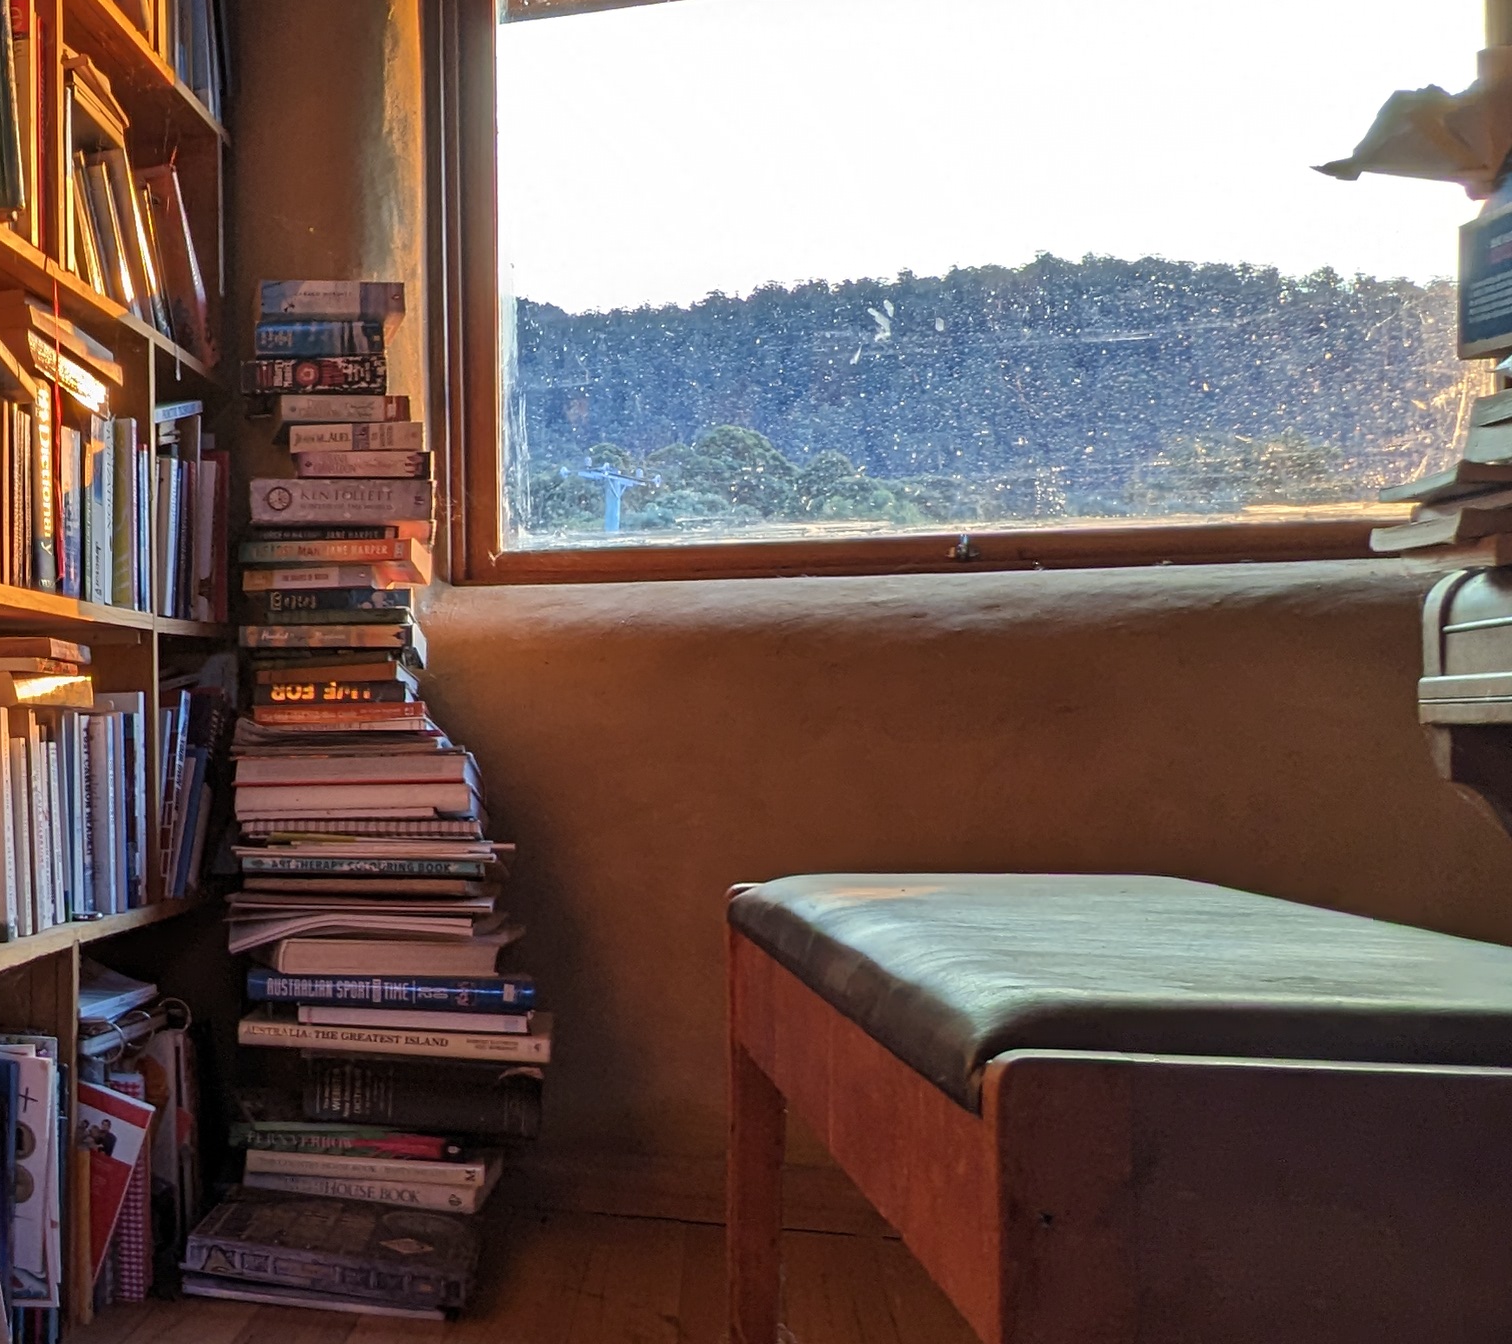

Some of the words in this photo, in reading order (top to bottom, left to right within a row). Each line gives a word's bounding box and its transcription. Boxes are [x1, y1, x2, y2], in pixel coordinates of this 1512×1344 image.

[37, 423, 54, 556] Dictionary
[300, 489, 329, 502] KEN
[351, 545, 389, 555] HARPER
[417, 862, 452, 874] BOOK
[266, 977, 335, 999] AUSTRALIAN
[336, 978, 373, 1000] SPORT
[313, 1029, 338, 1041] THE
[340, 1031, 401, 1046] GREATEST
[404, 1035, 450, 1048] ISLAND
[324, 1181, 375, 1200] HOUSE
[379, 1187, 421, 1204] BOOK
